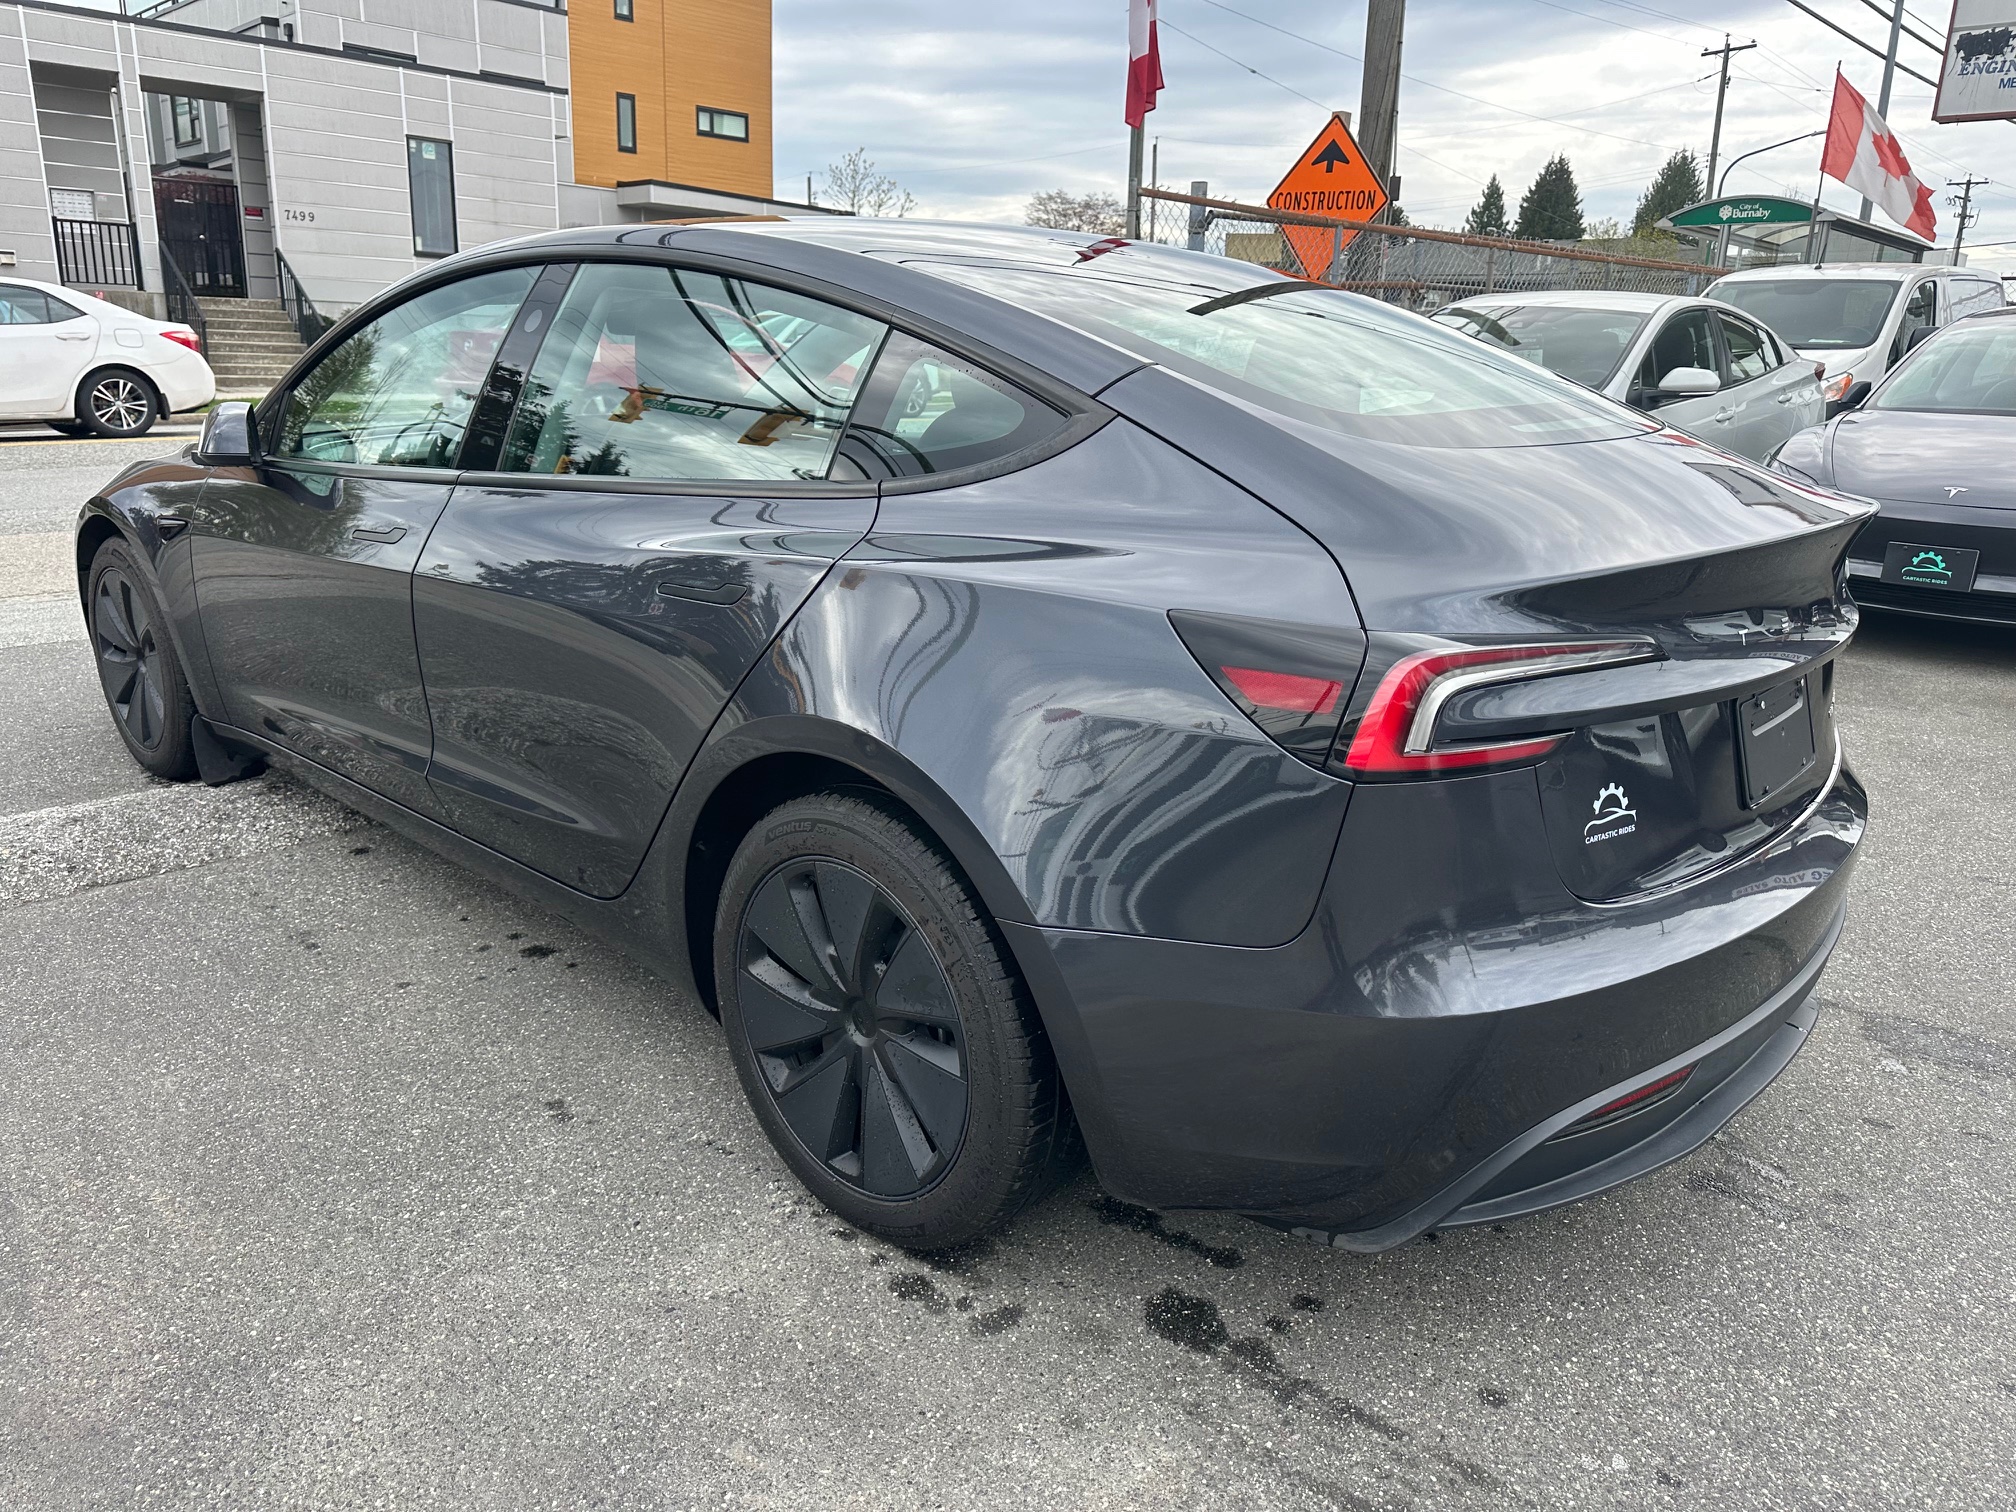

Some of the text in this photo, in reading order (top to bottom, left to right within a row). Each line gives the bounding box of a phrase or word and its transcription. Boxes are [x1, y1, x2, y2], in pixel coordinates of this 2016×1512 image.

[1275, 189, 1376, 211] CONSTRUCTION
[284, 209, 315, 223] 7499
[1732, 208, 1771, 220] Burnaby
[1585, 824, 1636, 844] CARTASTIC RIDES
[1773, 872, 1806, 885] AUTO
